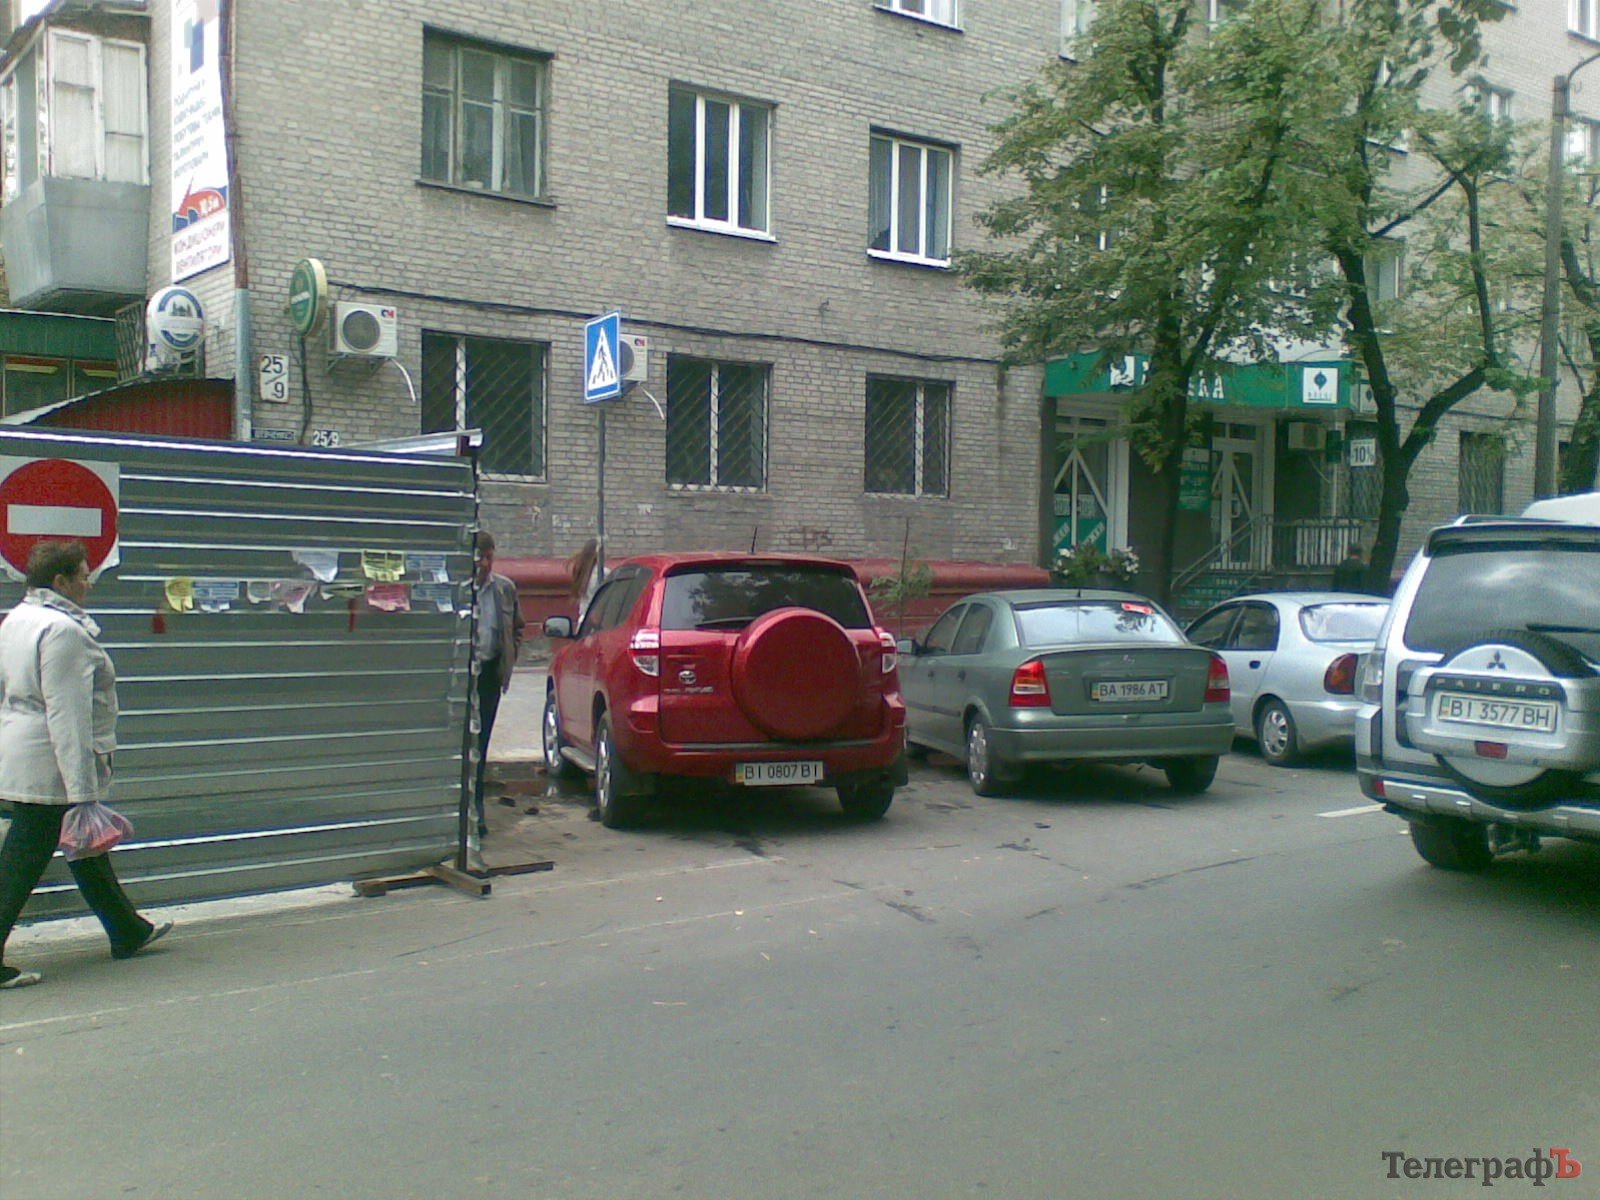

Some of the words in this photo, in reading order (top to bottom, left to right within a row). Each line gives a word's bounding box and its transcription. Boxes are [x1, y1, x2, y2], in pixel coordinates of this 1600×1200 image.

[261, 355, 284, 374] 25
[272, 382, 284, 399] 9
[313, 430, 339, 447] 25/9
[1100, 684, 1117, 697] BA
[1121, 683, 1146, 696] 1986
[1148, 683, 1165, 695] AT
[1451, 700, 1471, 718] BI
[1479, 702, 1519, 723] 3577
[1523, 707, 1550, 726] BH
[745, 765, 761, 780] BI
[767, 764, 798, 779] 0807
[801, 763, 817, 778] BI
